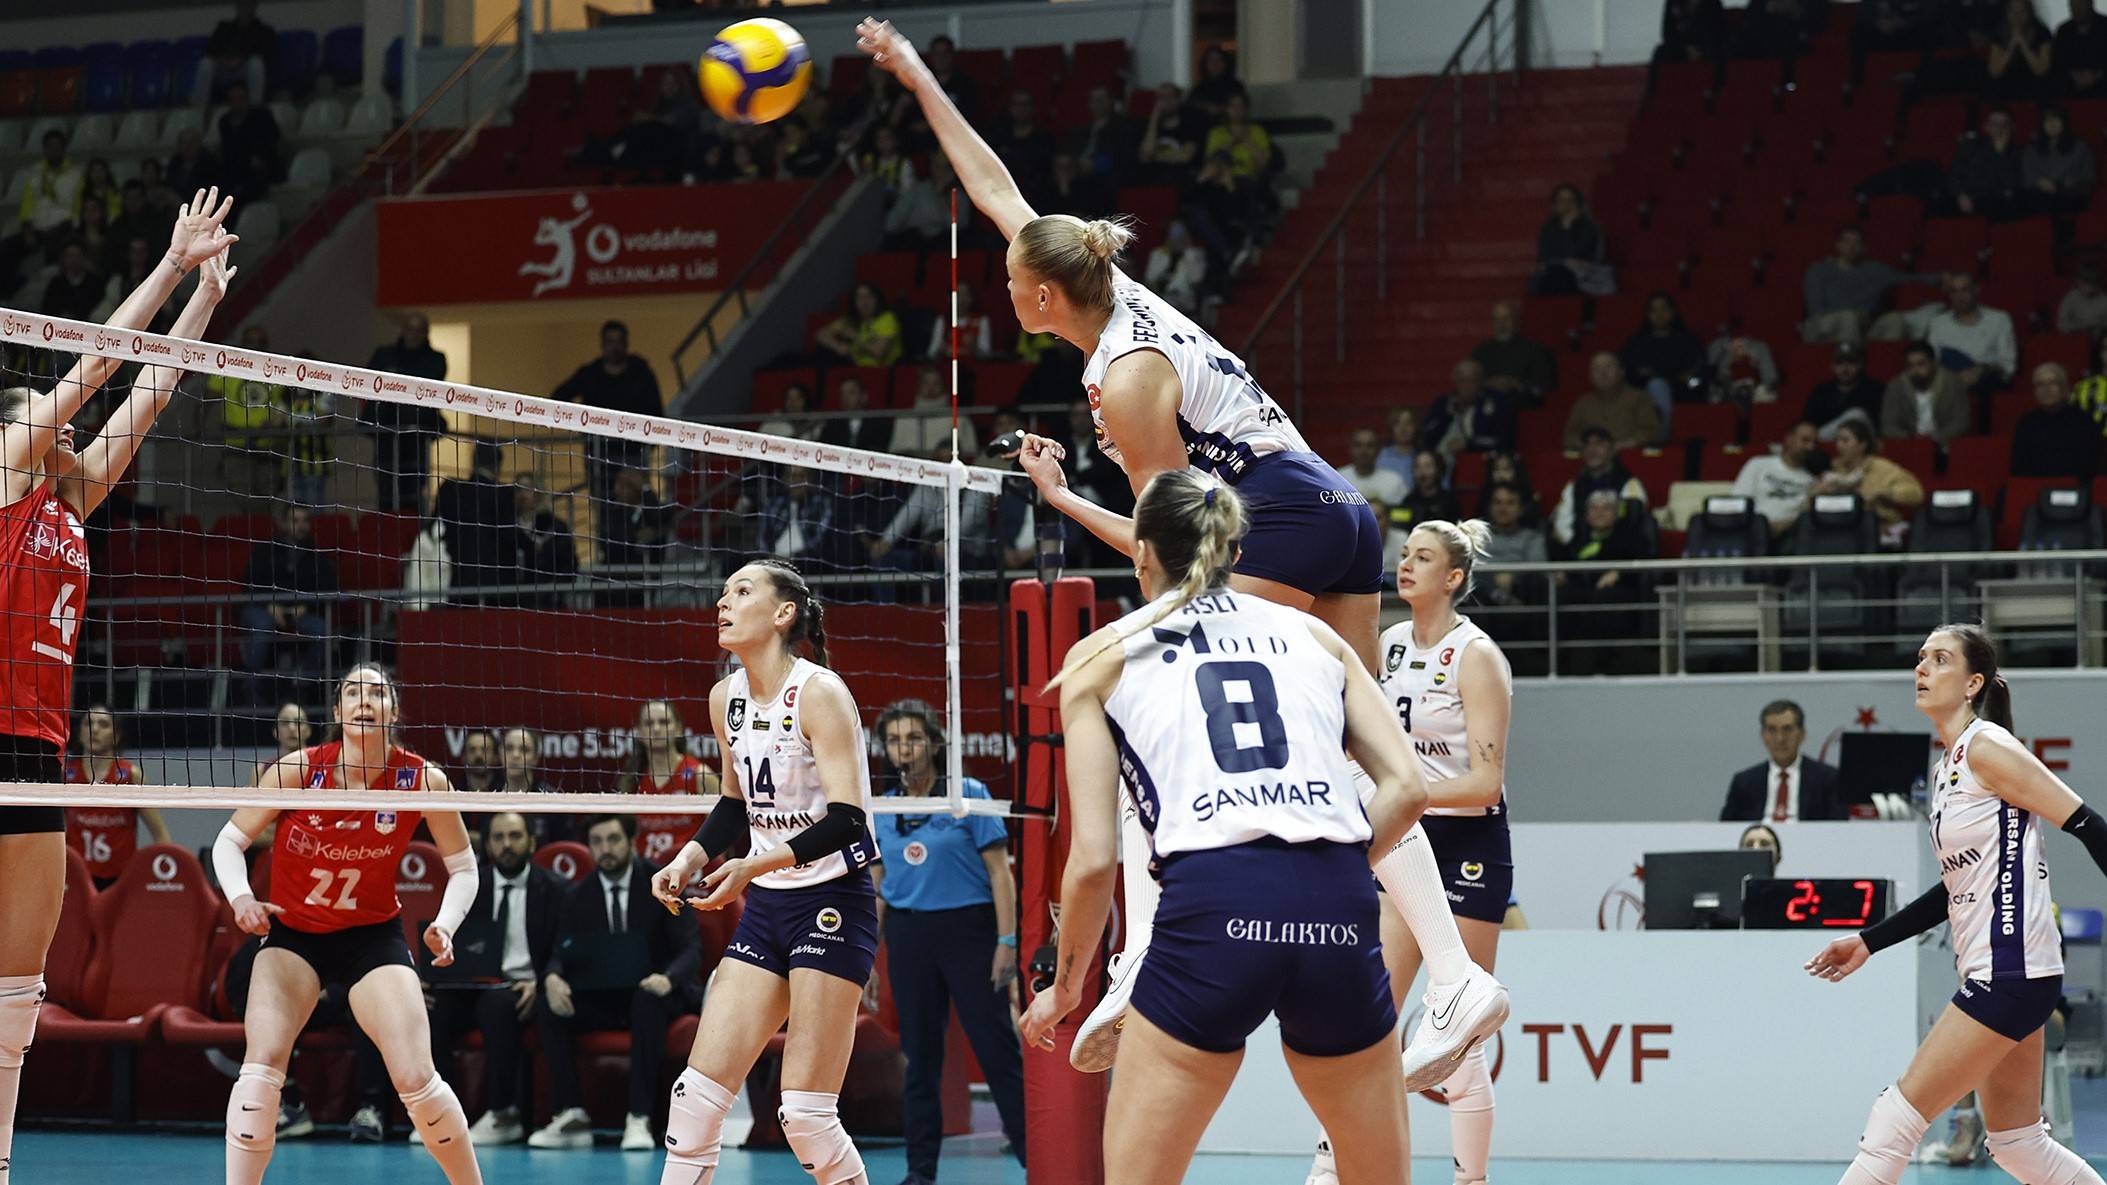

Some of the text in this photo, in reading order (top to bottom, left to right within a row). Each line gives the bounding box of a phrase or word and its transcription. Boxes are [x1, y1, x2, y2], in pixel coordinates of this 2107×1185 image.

[623, 226, 719, 252] vodafone
[16, 322, 31, 335] TVF
[54, 327, 84, 342] vodafone
[106, 338, 121, 350] TVF
[143, 342, 171, 355] vodafone
[192, 351, 206, 362] TVF
[226, 355, 253, 369] vodafone
[273, 365, 287, 376] TVF
[306, 368, 332, 382] vodafone
[351, 377, 364, 387] TVF
[383, 379, 407, 393] vodafone
[425, 388, 438, 399] TVF
[455, 392, 478, 405] vodafone
[494, 400, 507, 410] TVF
[523, 405, 545, 416] vodafone
[561, 411, 573, 420] TVF
[32, 582, 76, 666] 14
[1195, 661, 1290, 774] 8
[743, 756, 776, 800] 14
[1192, 780, 1332, 822] SANMAR
[80, 829, 113, 864] 16
[315, 844, 394, 861] Kelebek
[304, 867, 361, 911] 22
[1226, 918, 1359, 946] GALAKTOS
[1522, 1024, 1672, 1084] TVF
